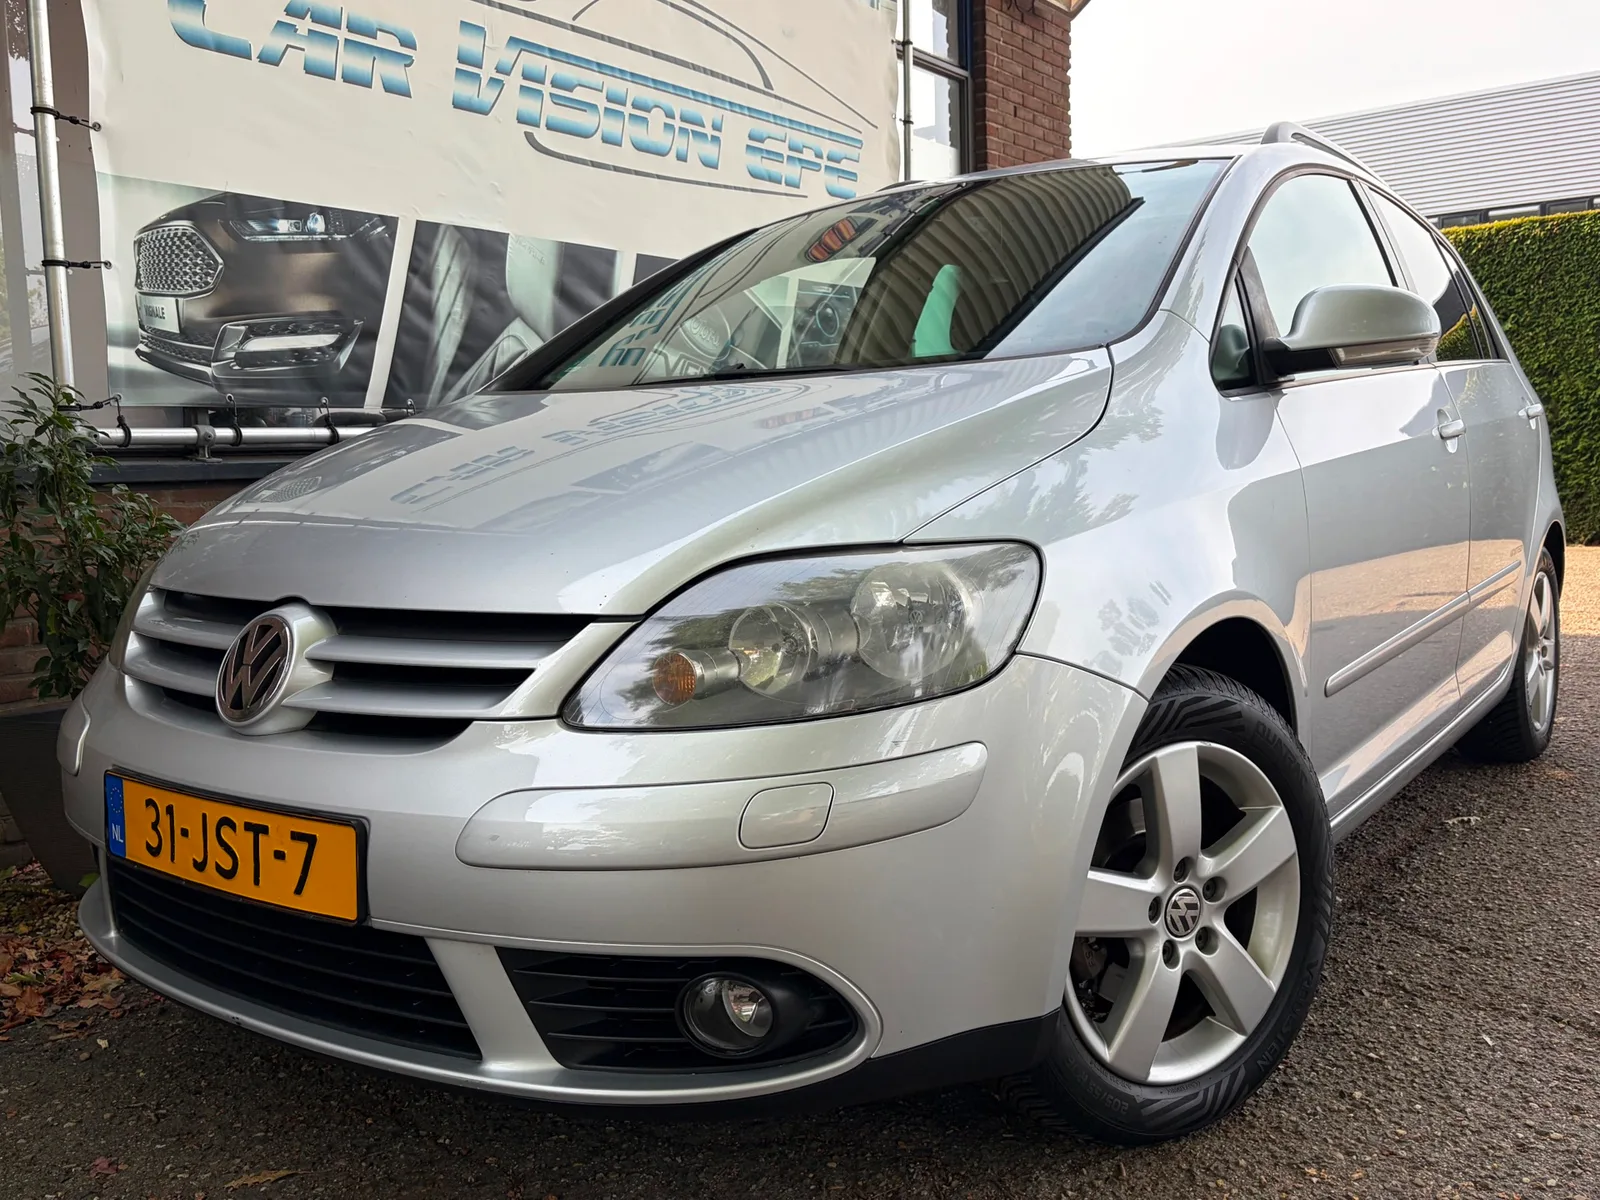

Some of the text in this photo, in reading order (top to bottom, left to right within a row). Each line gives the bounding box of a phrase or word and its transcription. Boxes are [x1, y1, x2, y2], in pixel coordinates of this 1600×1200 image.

[167, 0, 418, 98] CAR
[452, 20, 724, 169] VISION
[143, 304, 166, 320] VIGNALE
[111, 822, 124, 844] NL
[144, 797, 318, 896] 31-JST-7
